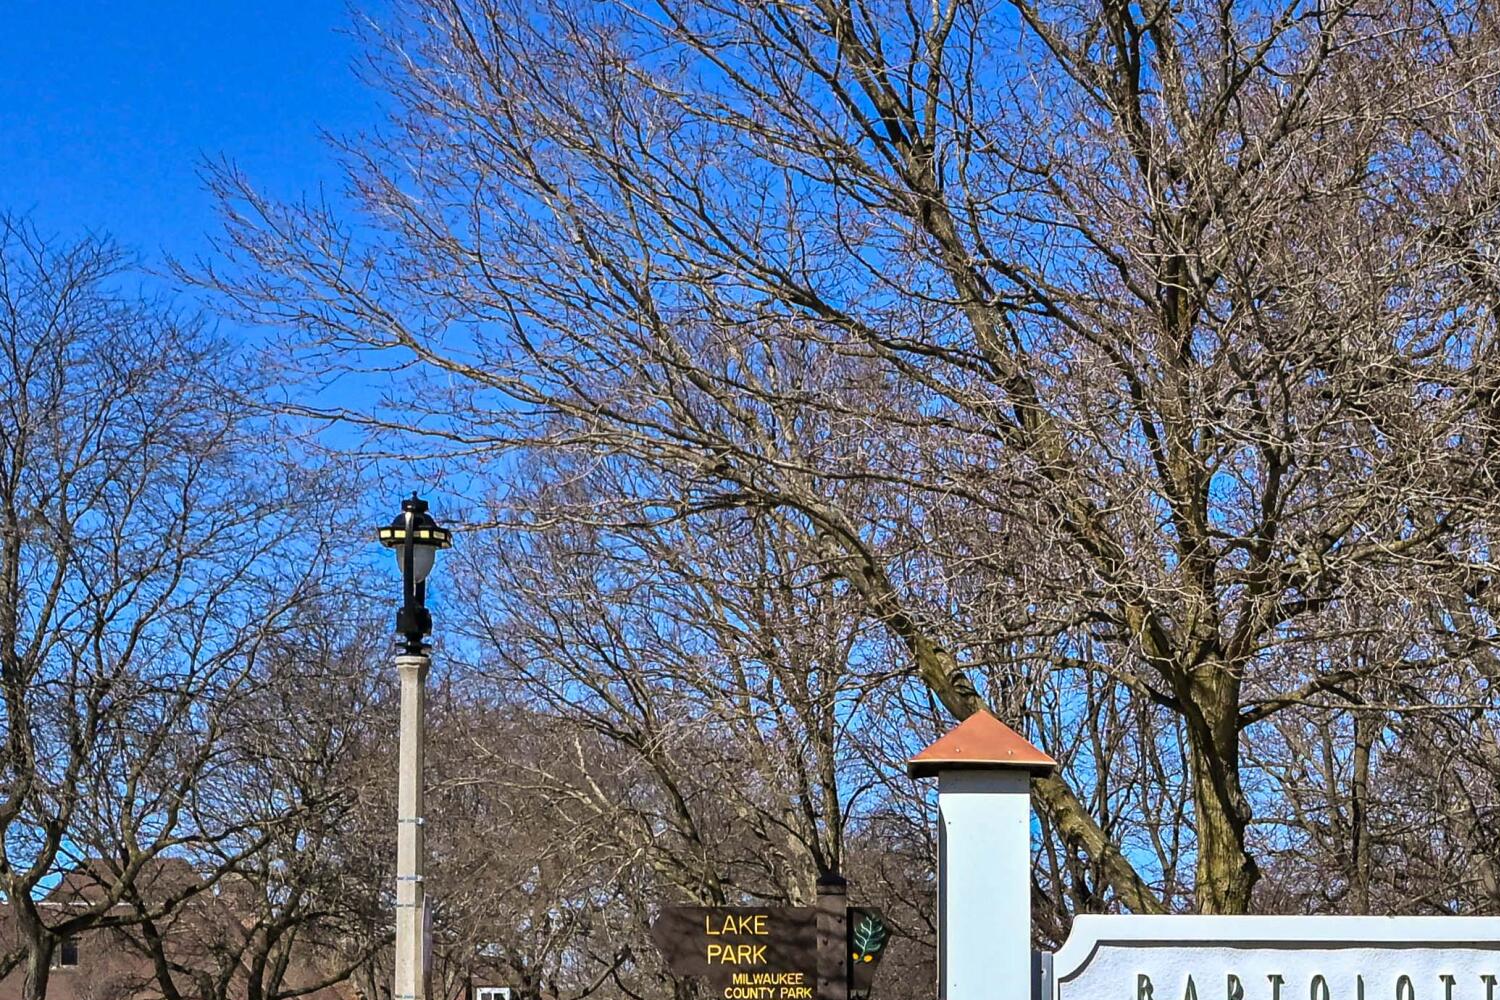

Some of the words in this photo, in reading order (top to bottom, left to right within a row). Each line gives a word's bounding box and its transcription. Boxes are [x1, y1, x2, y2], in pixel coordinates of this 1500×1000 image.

[705, 914, 769, 936] LAKE
[707, 944, 768, 965] PARK
[732, 972, 804, 986] MILWAUKEE
[724, 986, 775, 1000] COUNTY
[780, 986, 813, 1000] PARK
